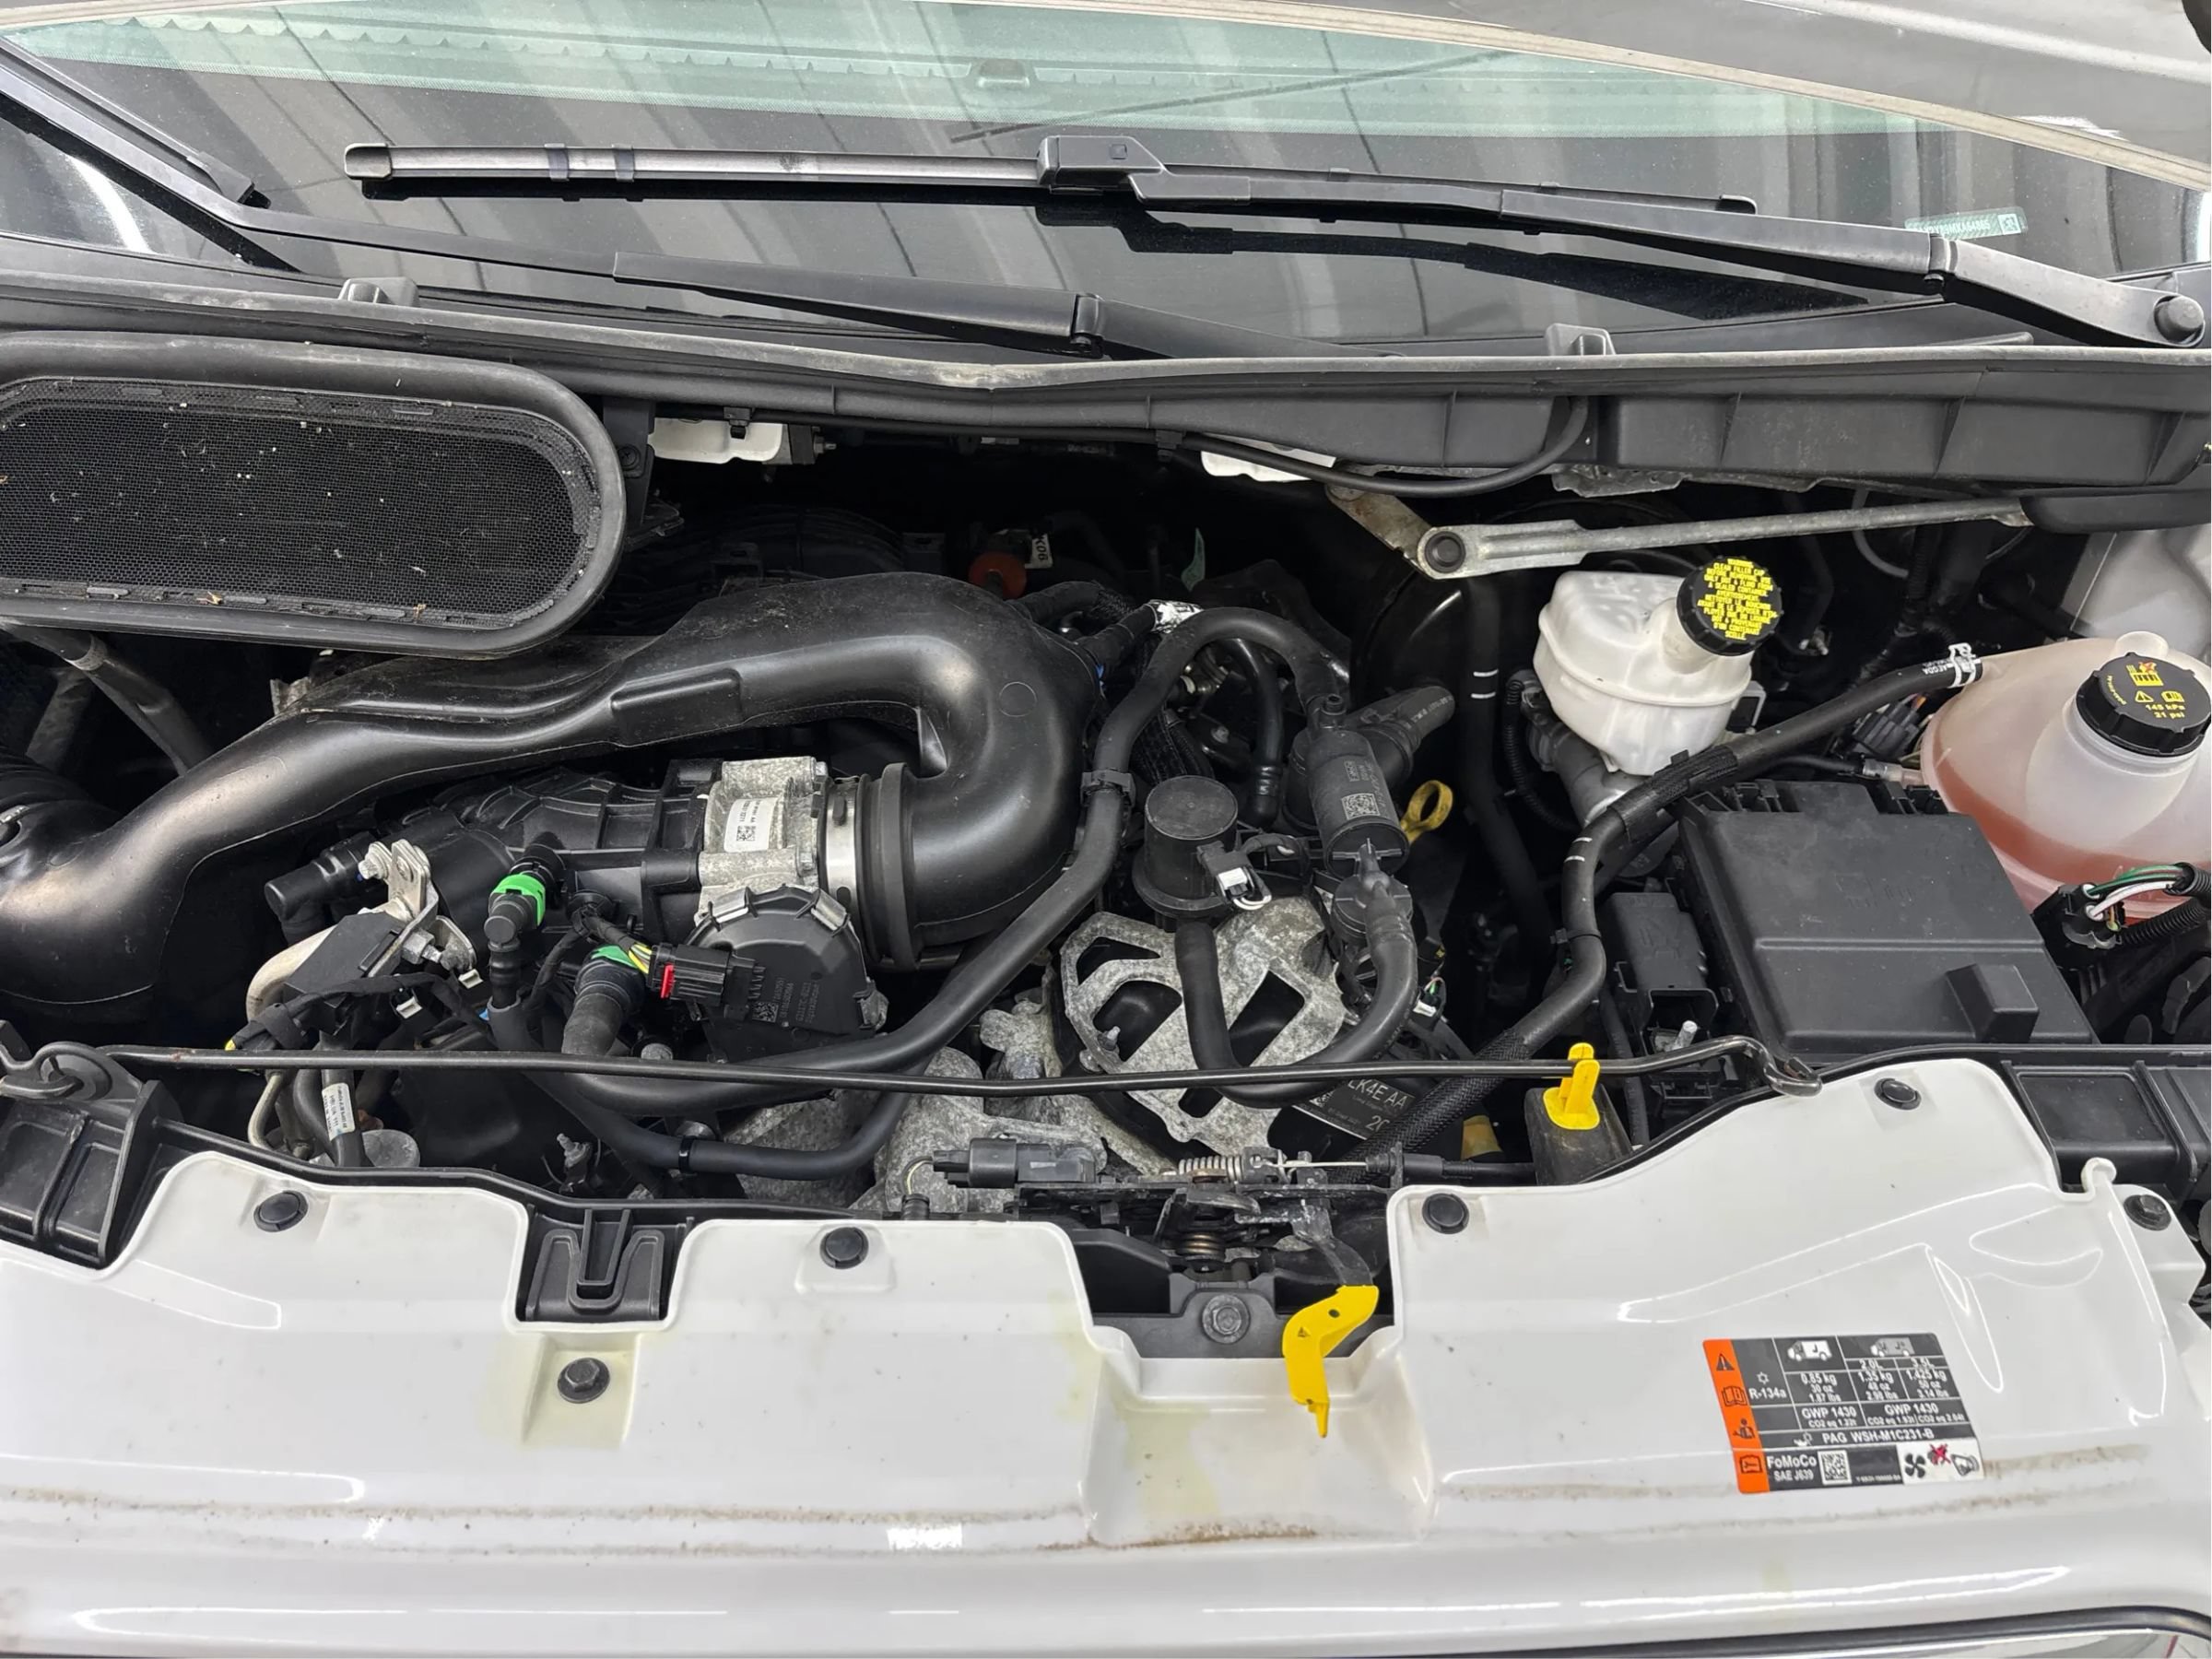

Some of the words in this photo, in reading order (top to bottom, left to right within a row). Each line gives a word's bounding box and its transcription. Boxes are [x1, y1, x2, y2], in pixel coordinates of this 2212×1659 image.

[1383, 1091, 1407, 1107] AA
[1800, 1373, 1823, 1385] 0.85
[1822, 1371, 1838, 1386] kg
[1858, 1371, 1879, 1382] 1.35
[1879, 1370, 1894, 1383] kg
[1932, 1368, 1947, 1382] kg
[1748, 1387, 1787, 1399] R-134a
[1801, 1407, 1829, 1419] GWP
[1830, 1406, 1857, 1418] 1430
[1884, 1404, 1912, 1416] GWP
[1913, 1403, 1939, 1414] 1430
[1807, 1419, 1826, 1429] CO2
[1867, 1417, 1885, 1426] CO2
[1918, 1414, 1936, 1423] CO2
[1822, 1432, 1847, 1444] PAG
[1850, 1428, 1935, 1442] WSH-M1C231-B
[1767, 1454, 1817, 1469] FoMoCo
[1773, 1470, 1794, 1482] SAE
[1794, 1469, 1814, 1480] J639
